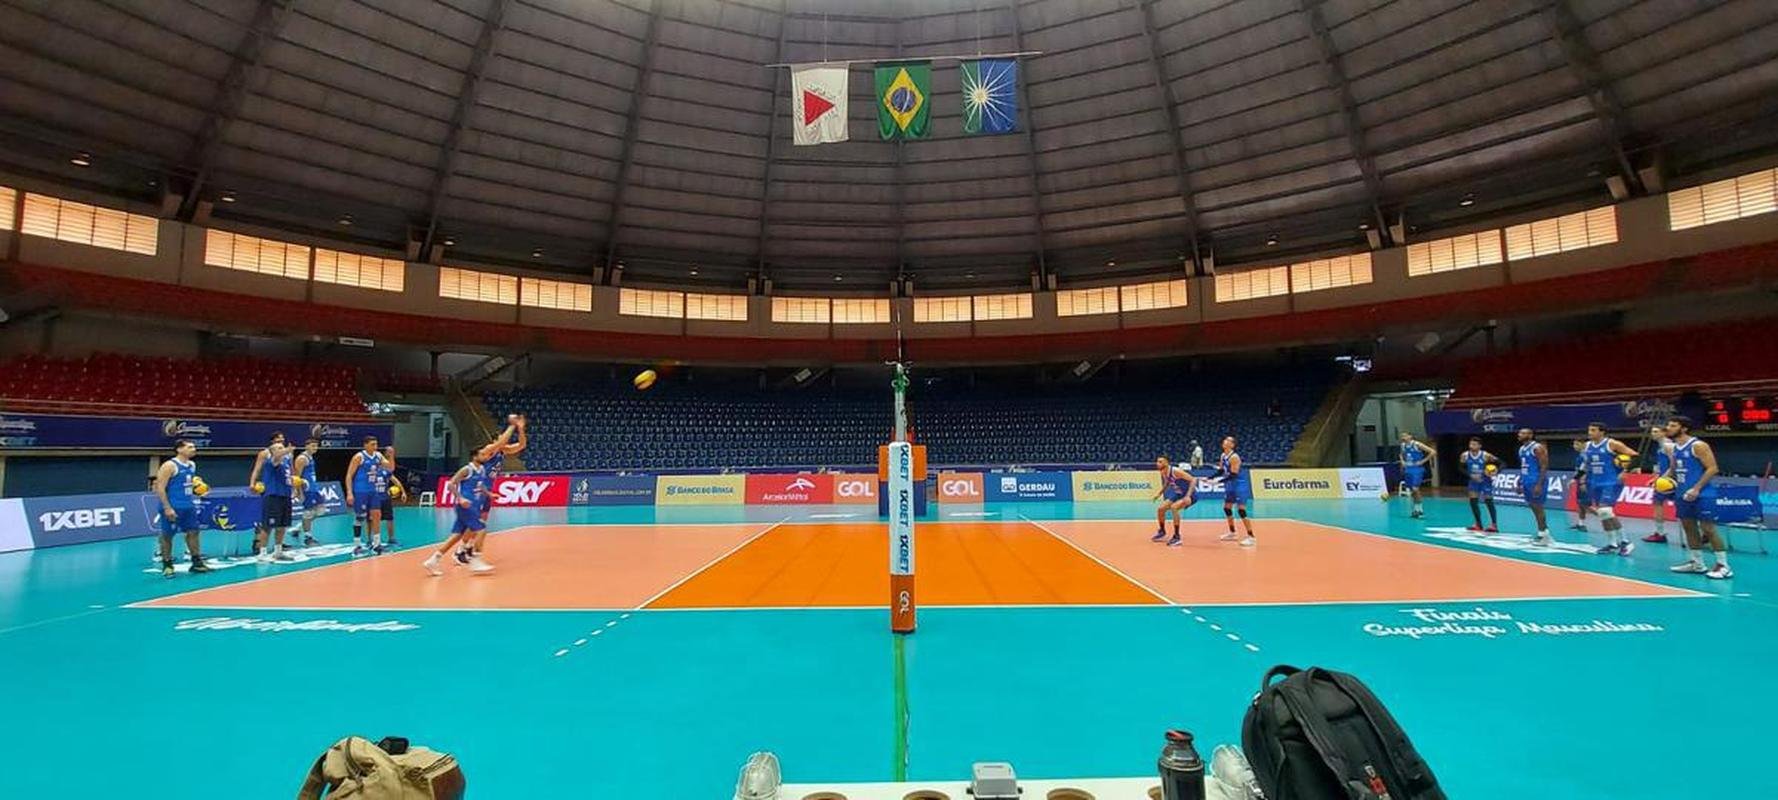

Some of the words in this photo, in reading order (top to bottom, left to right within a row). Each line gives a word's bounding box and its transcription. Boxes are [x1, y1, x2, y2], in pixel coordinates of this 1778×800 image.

[495, 480, 550, 504] SKY
[838, 481, 874, 497] GOL
[943, 480, 979, 496] GOL
[1019, 483, 1056, 492] GERDAU
[1263, 478, 1330, 490] Eurofarma
[1346, 482, 1360, 492] EY
[900, 490, 909, 527] 1XBET
[39, 506, 125, 532] 1XBET
[900, 535, 909, 573] 1XBET
[1399, 607, 1511, 623] Finais
[1363, 622, 1507, 639] Superliga
[1515, 620, 1664, 634] Masculina
